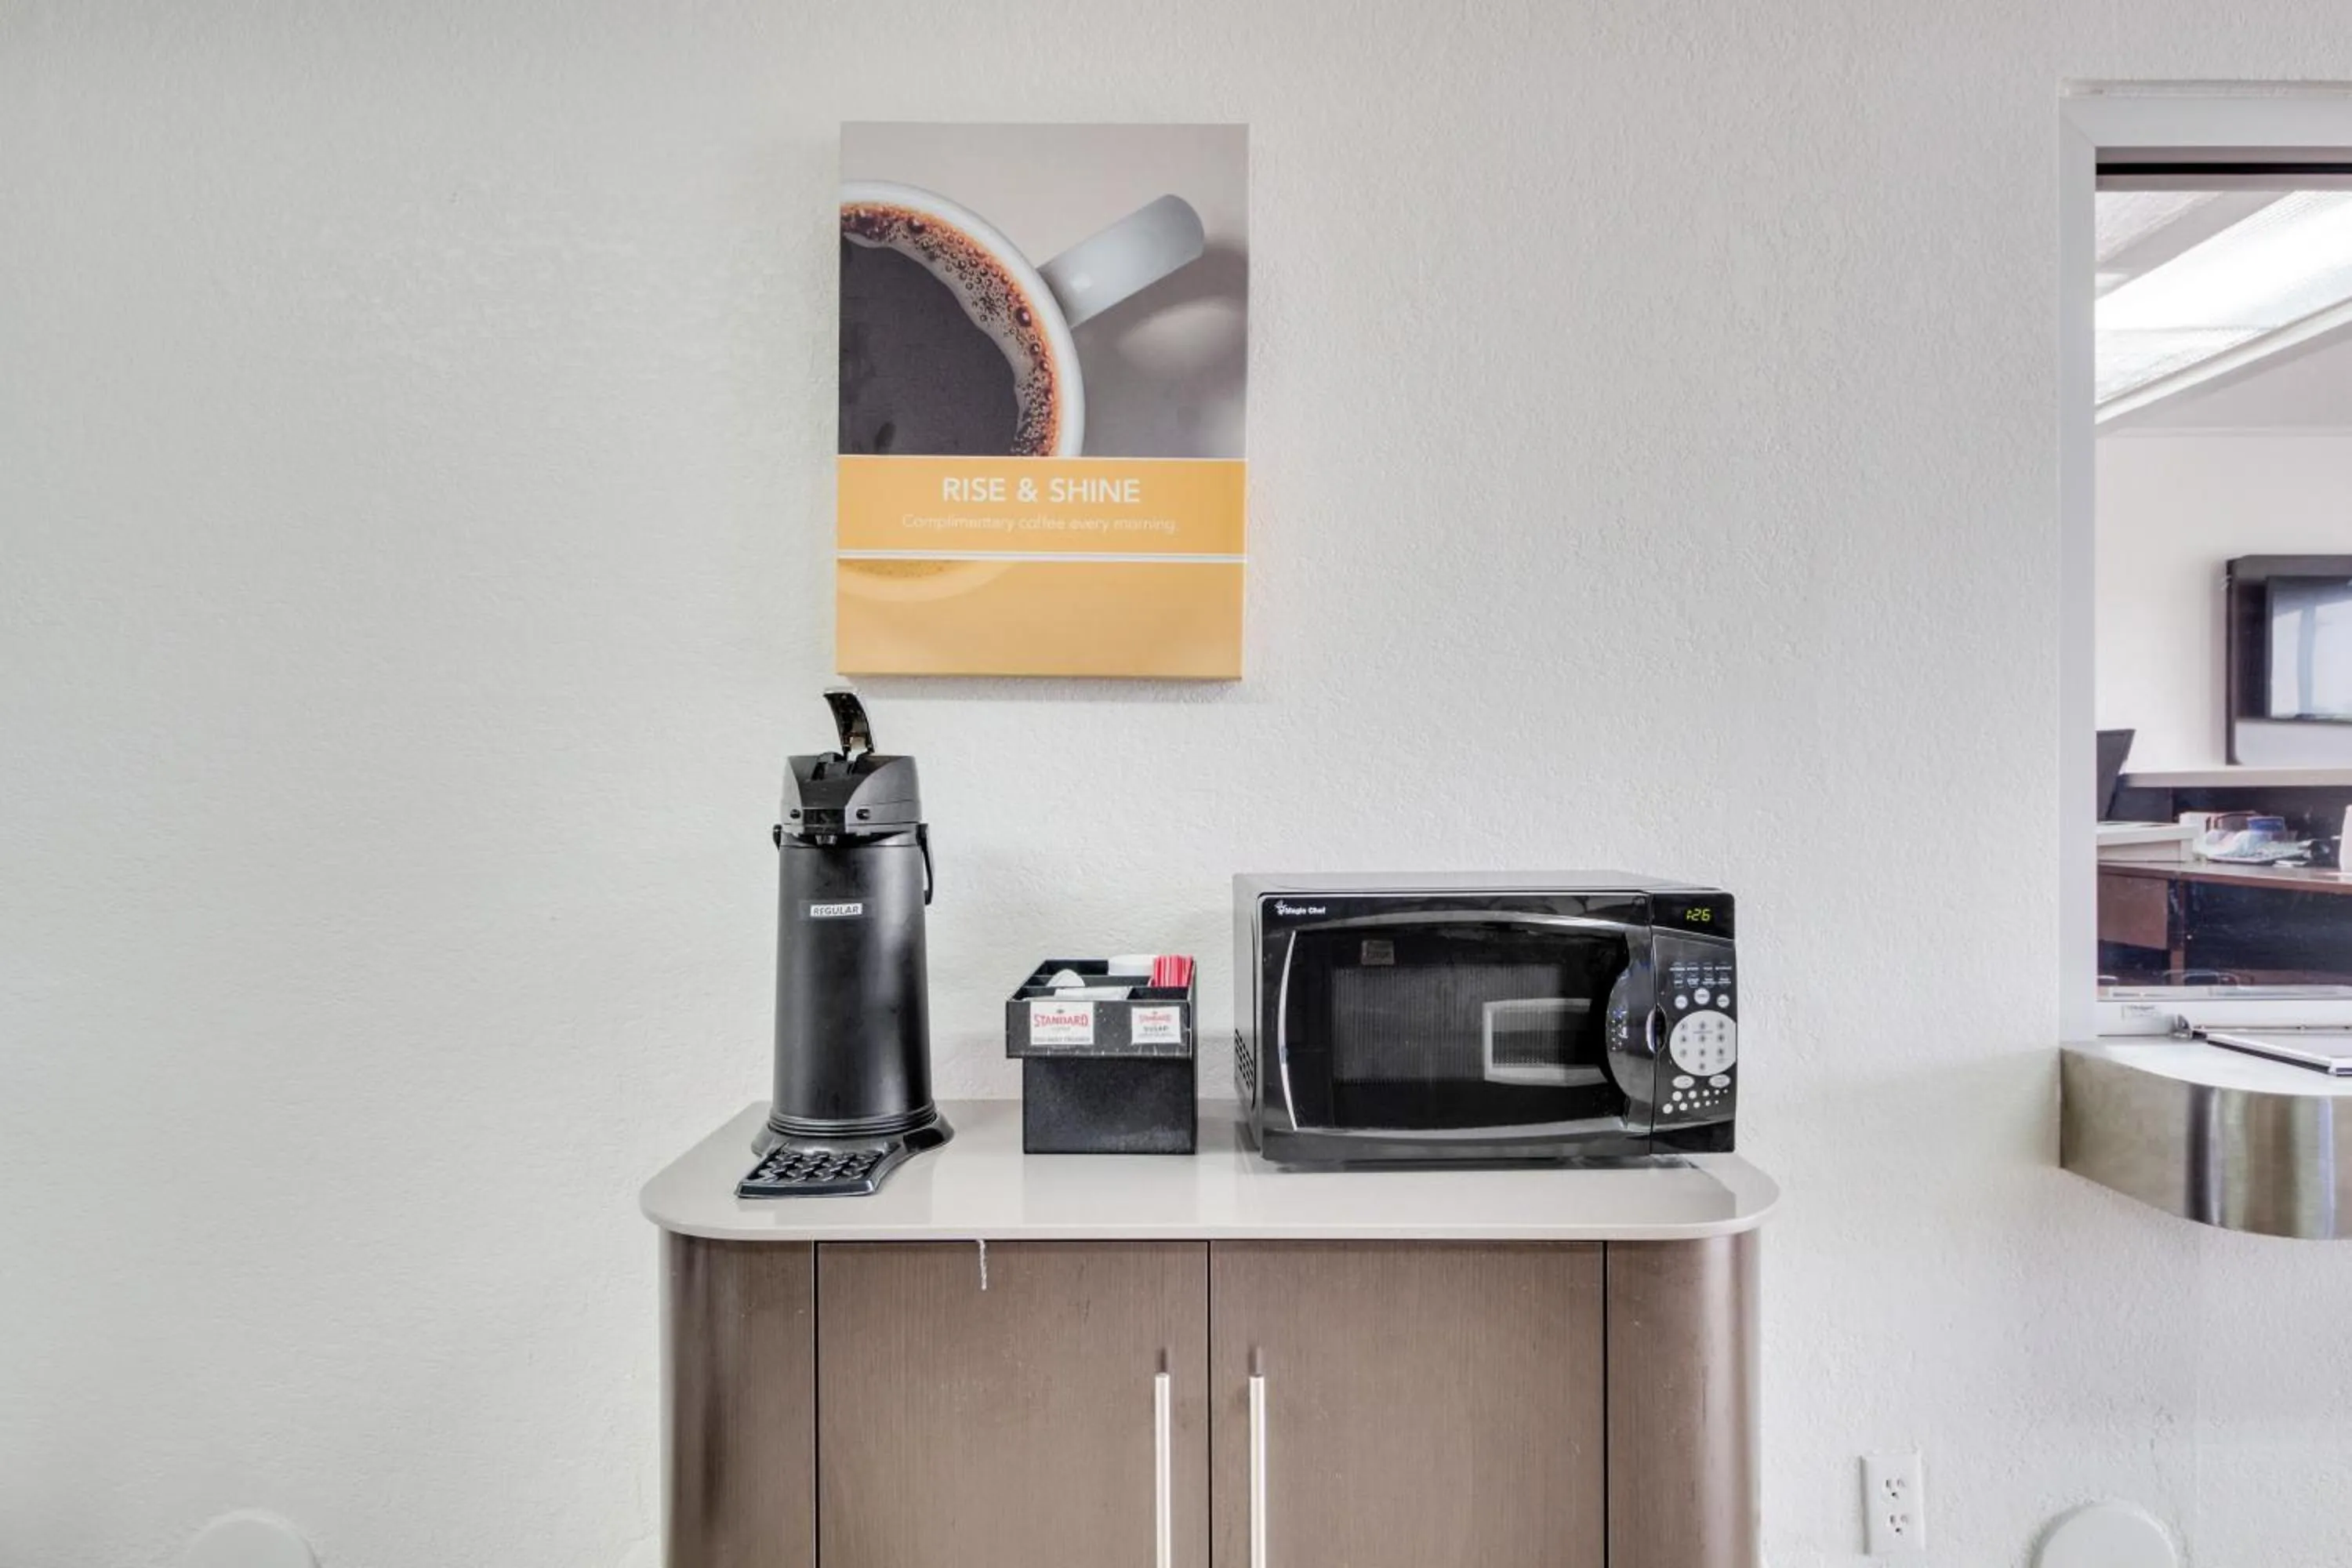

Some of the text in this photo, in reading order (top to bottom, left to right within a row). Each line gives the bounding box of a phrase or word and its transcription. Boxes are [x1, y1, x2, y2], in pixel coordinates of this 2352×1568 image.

[943, 477, 1140, 503] RISE & SHINE
[1018, 514, 1065, 530] coffee
[1070, 517, 1109, 533] every
[813, 906, 859, 915] REGULAR
[1033, 1013, 1089, 1028] STANDARD
